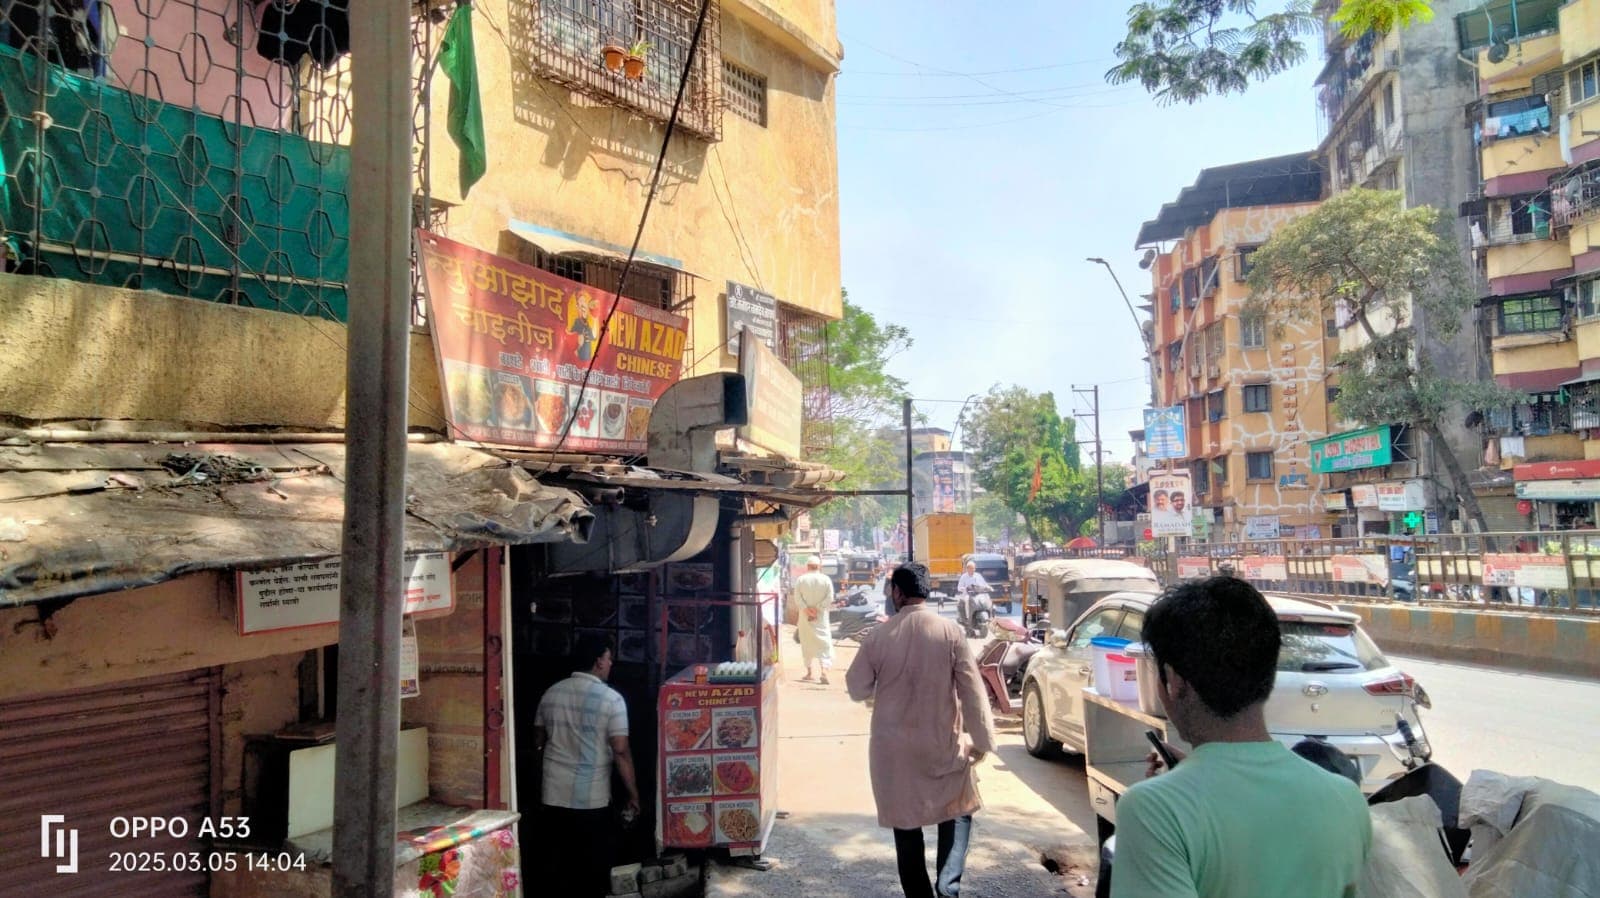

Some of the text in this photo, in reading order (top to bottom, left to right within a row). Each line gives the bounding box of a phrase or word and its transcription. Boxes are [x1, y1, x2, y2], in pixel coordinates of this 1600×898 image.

[472, 260, 564, 320] आझाद
[608, 310, 637, 350] NEW
[640, 319, 687, 360] AZAD
[616, 352, 672, 380] CHINESE
[698, 697, 739, 706] CHINESE
[711, 687, 754, 697] AZAD
